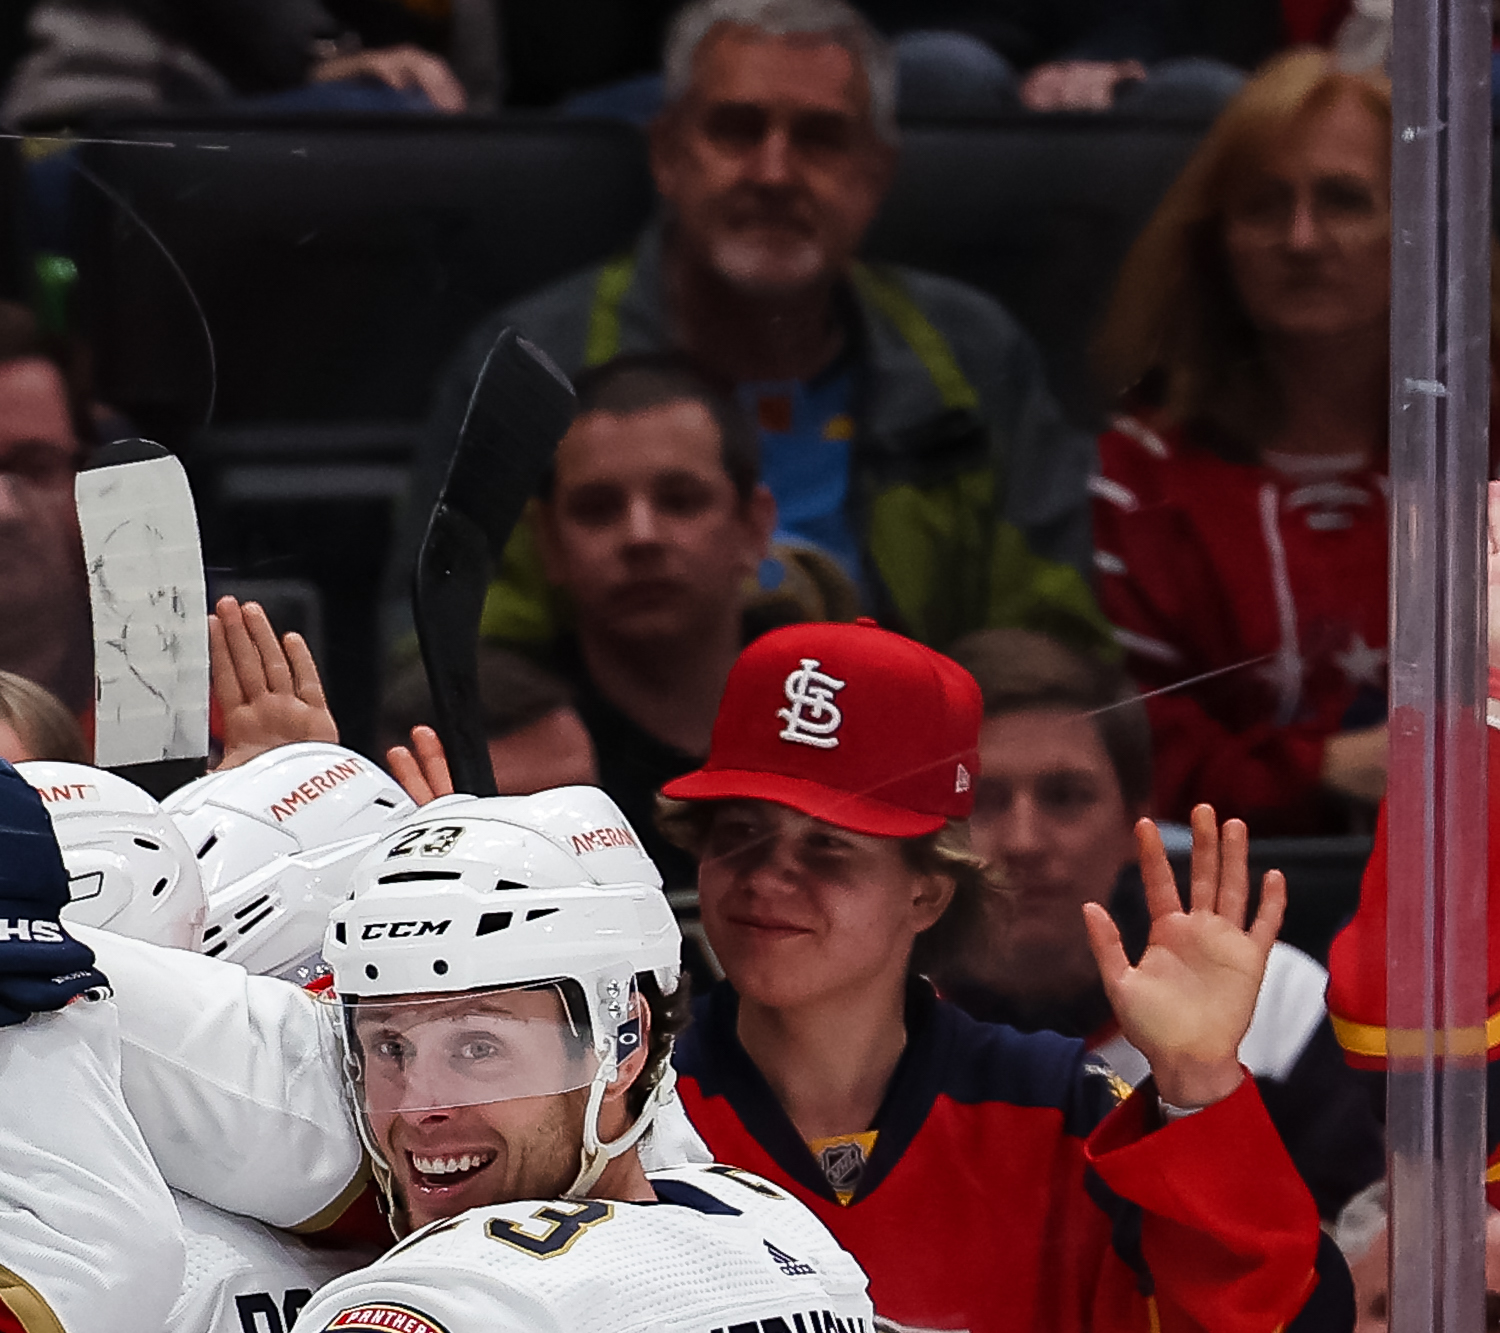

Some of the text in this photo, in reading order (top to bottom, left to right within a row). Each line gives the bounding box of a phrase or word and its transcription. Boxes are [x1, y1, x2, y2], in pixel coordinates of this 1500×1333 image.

[269, 757, 368, 824] AMERANT
[385, 825, 467, 863] 23
[361, 919, 453, 942] CCM
